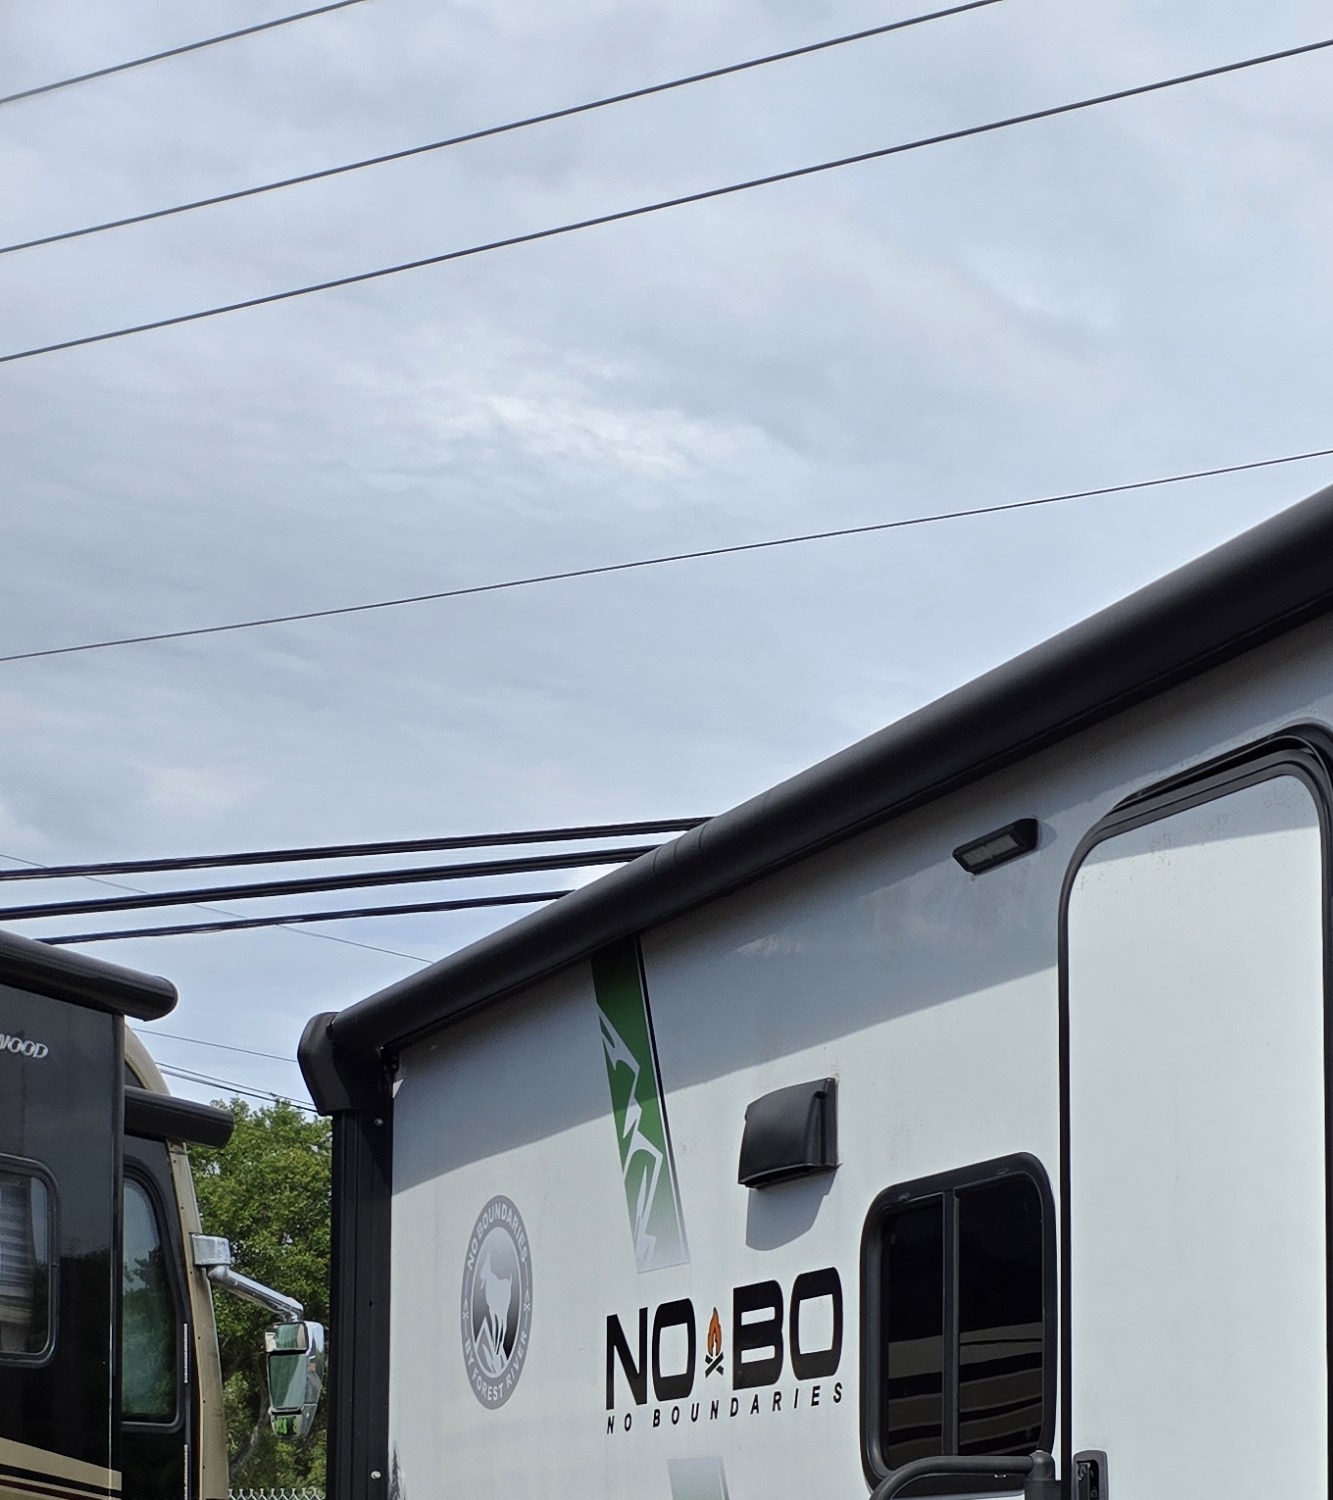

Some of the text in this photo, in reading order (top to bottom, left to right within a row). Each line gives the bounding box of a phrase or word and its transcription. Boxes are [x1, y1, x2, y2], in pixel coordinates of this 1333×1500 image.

[467, 1202, 527, 1271] NO BOUNDARIES
[464, 1332, 528, 1402] BY FOREST RIVER
[606, 1381, 843, 1436] NO BOUNDARIES
